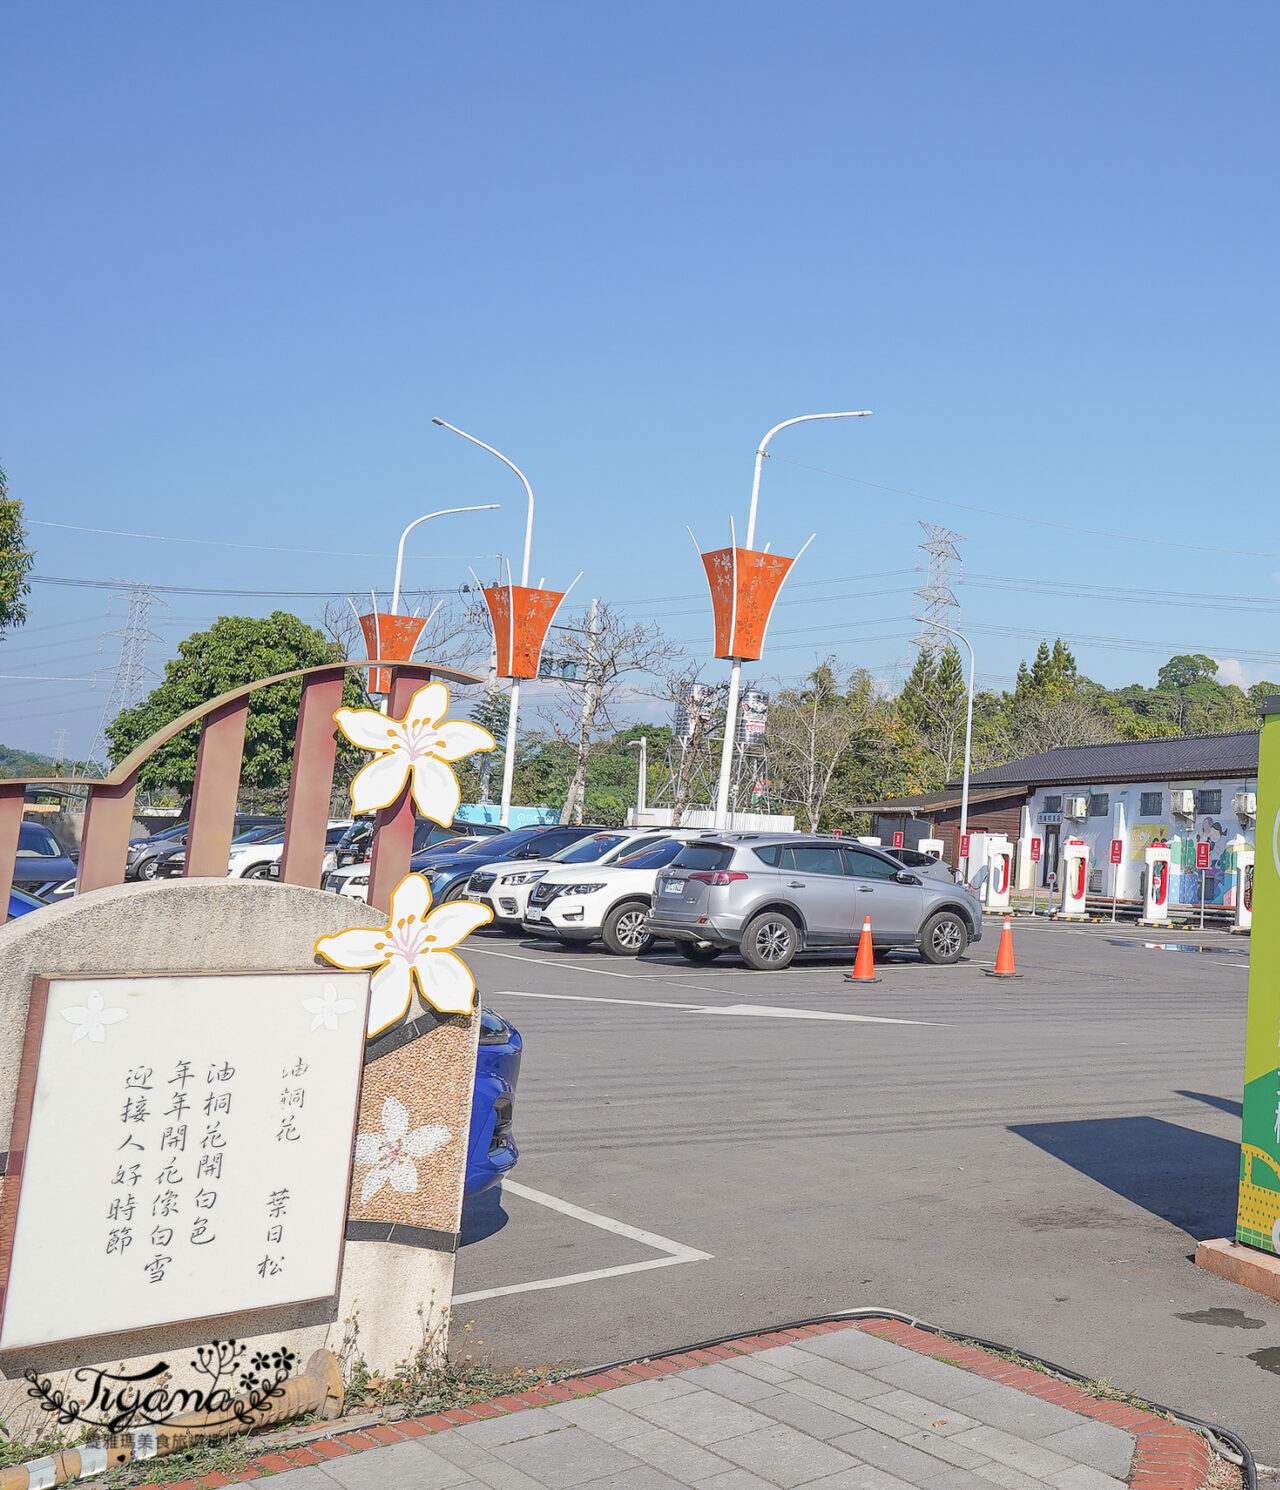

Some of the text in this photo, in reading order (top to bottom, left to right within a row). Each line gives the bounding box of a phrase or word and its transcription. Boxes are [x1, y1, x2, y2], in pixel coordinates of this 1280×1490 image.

[106, 1065, 154, 1255] 迎接人好時節
[144, 1060, 195, 1284] 年年開花像白雪
[190, 1061, 236, 1245] 油桐花開白色
[257, 1188, 290, 1279] 葉日松
